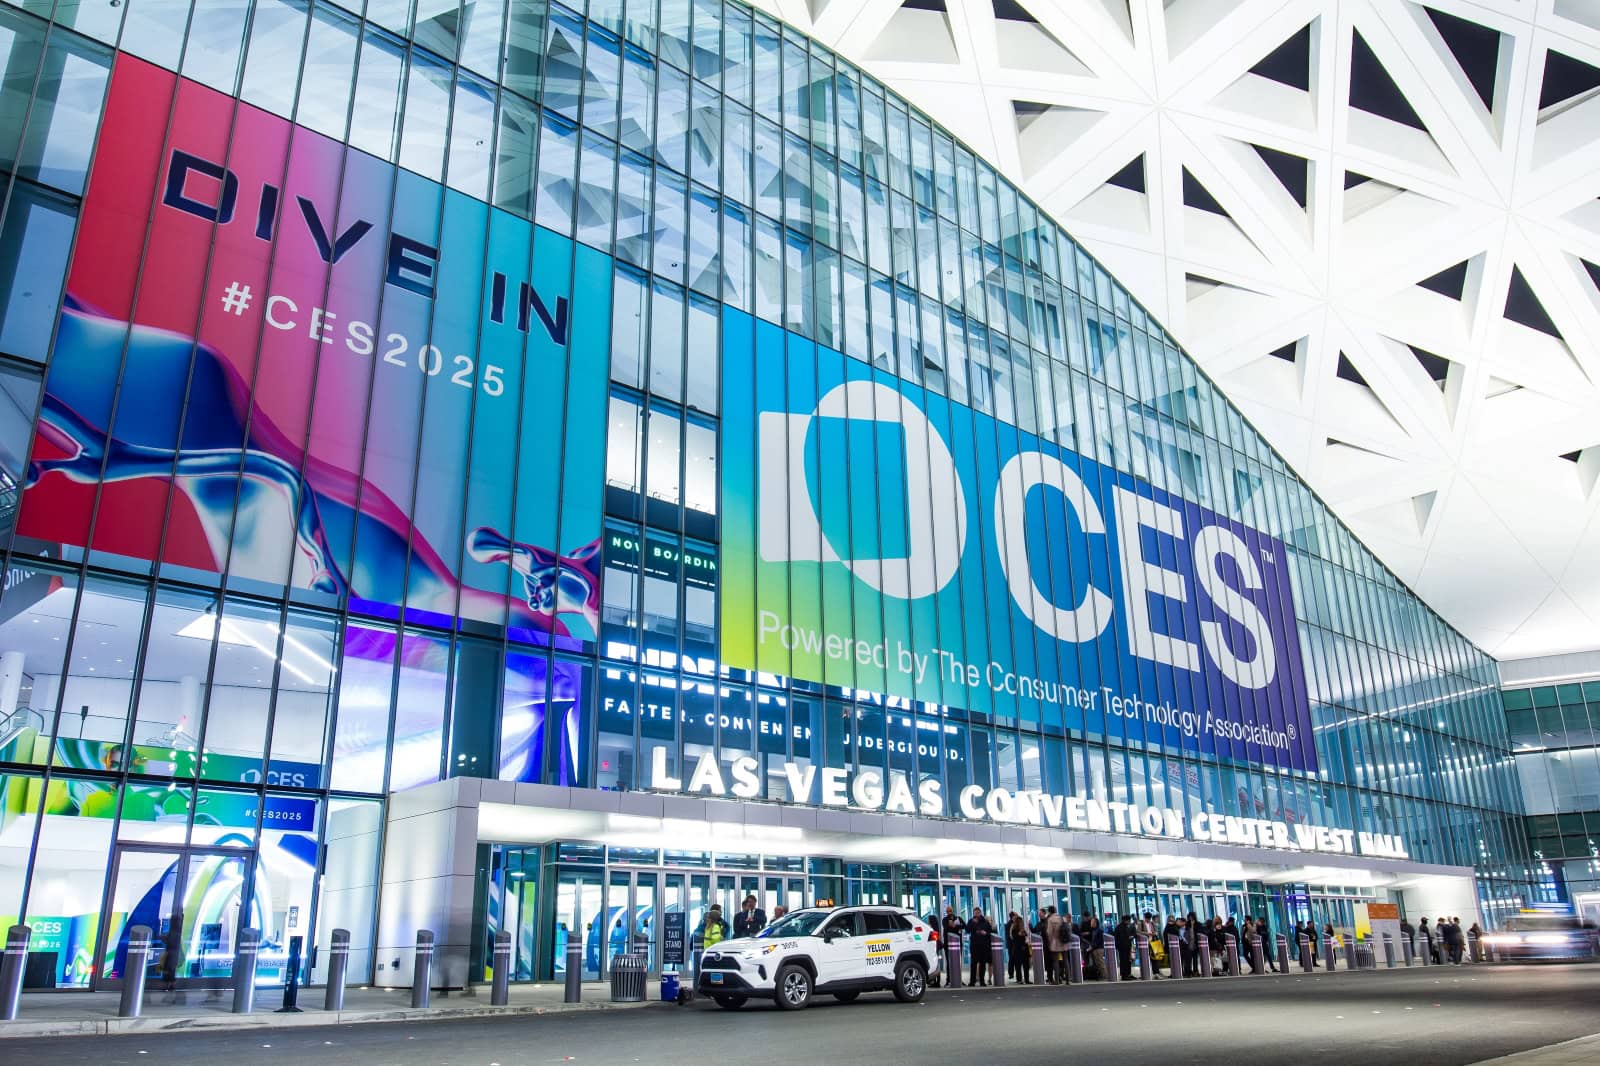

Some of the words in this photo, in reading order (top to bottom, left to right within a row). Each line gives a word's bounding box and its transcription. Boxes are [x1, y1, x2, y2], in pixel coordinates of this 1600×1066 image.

[163, 148, 441, 300] DIVE
[489, 271, 569, 346] IN
[221, 281, 505, 397] #CES2025
[759, 610, 889, 668] Powered
[897, 641, 928, 684] by
[932, 648, 980, 687] The
[986, 661, 1099, 711] Consumer
[1100, 686, 1201, 739] Technology
[652, 746, 760, 798] LAS
[784, 762, 943, 816] VEGAS
[960, 784, 1185, 838] CONVENTION
[1192, 812, 1292, 849] CENTER
[1294, 823, 1354, 854] WEST
[1358, 831, 1409, 859] HALL
[31, 921, 62, 934] CES
[664, 940, 682, 949] STAND
[668, 930, 680, 939] TAXI
[867, 943, 891, 953] YELLOW
